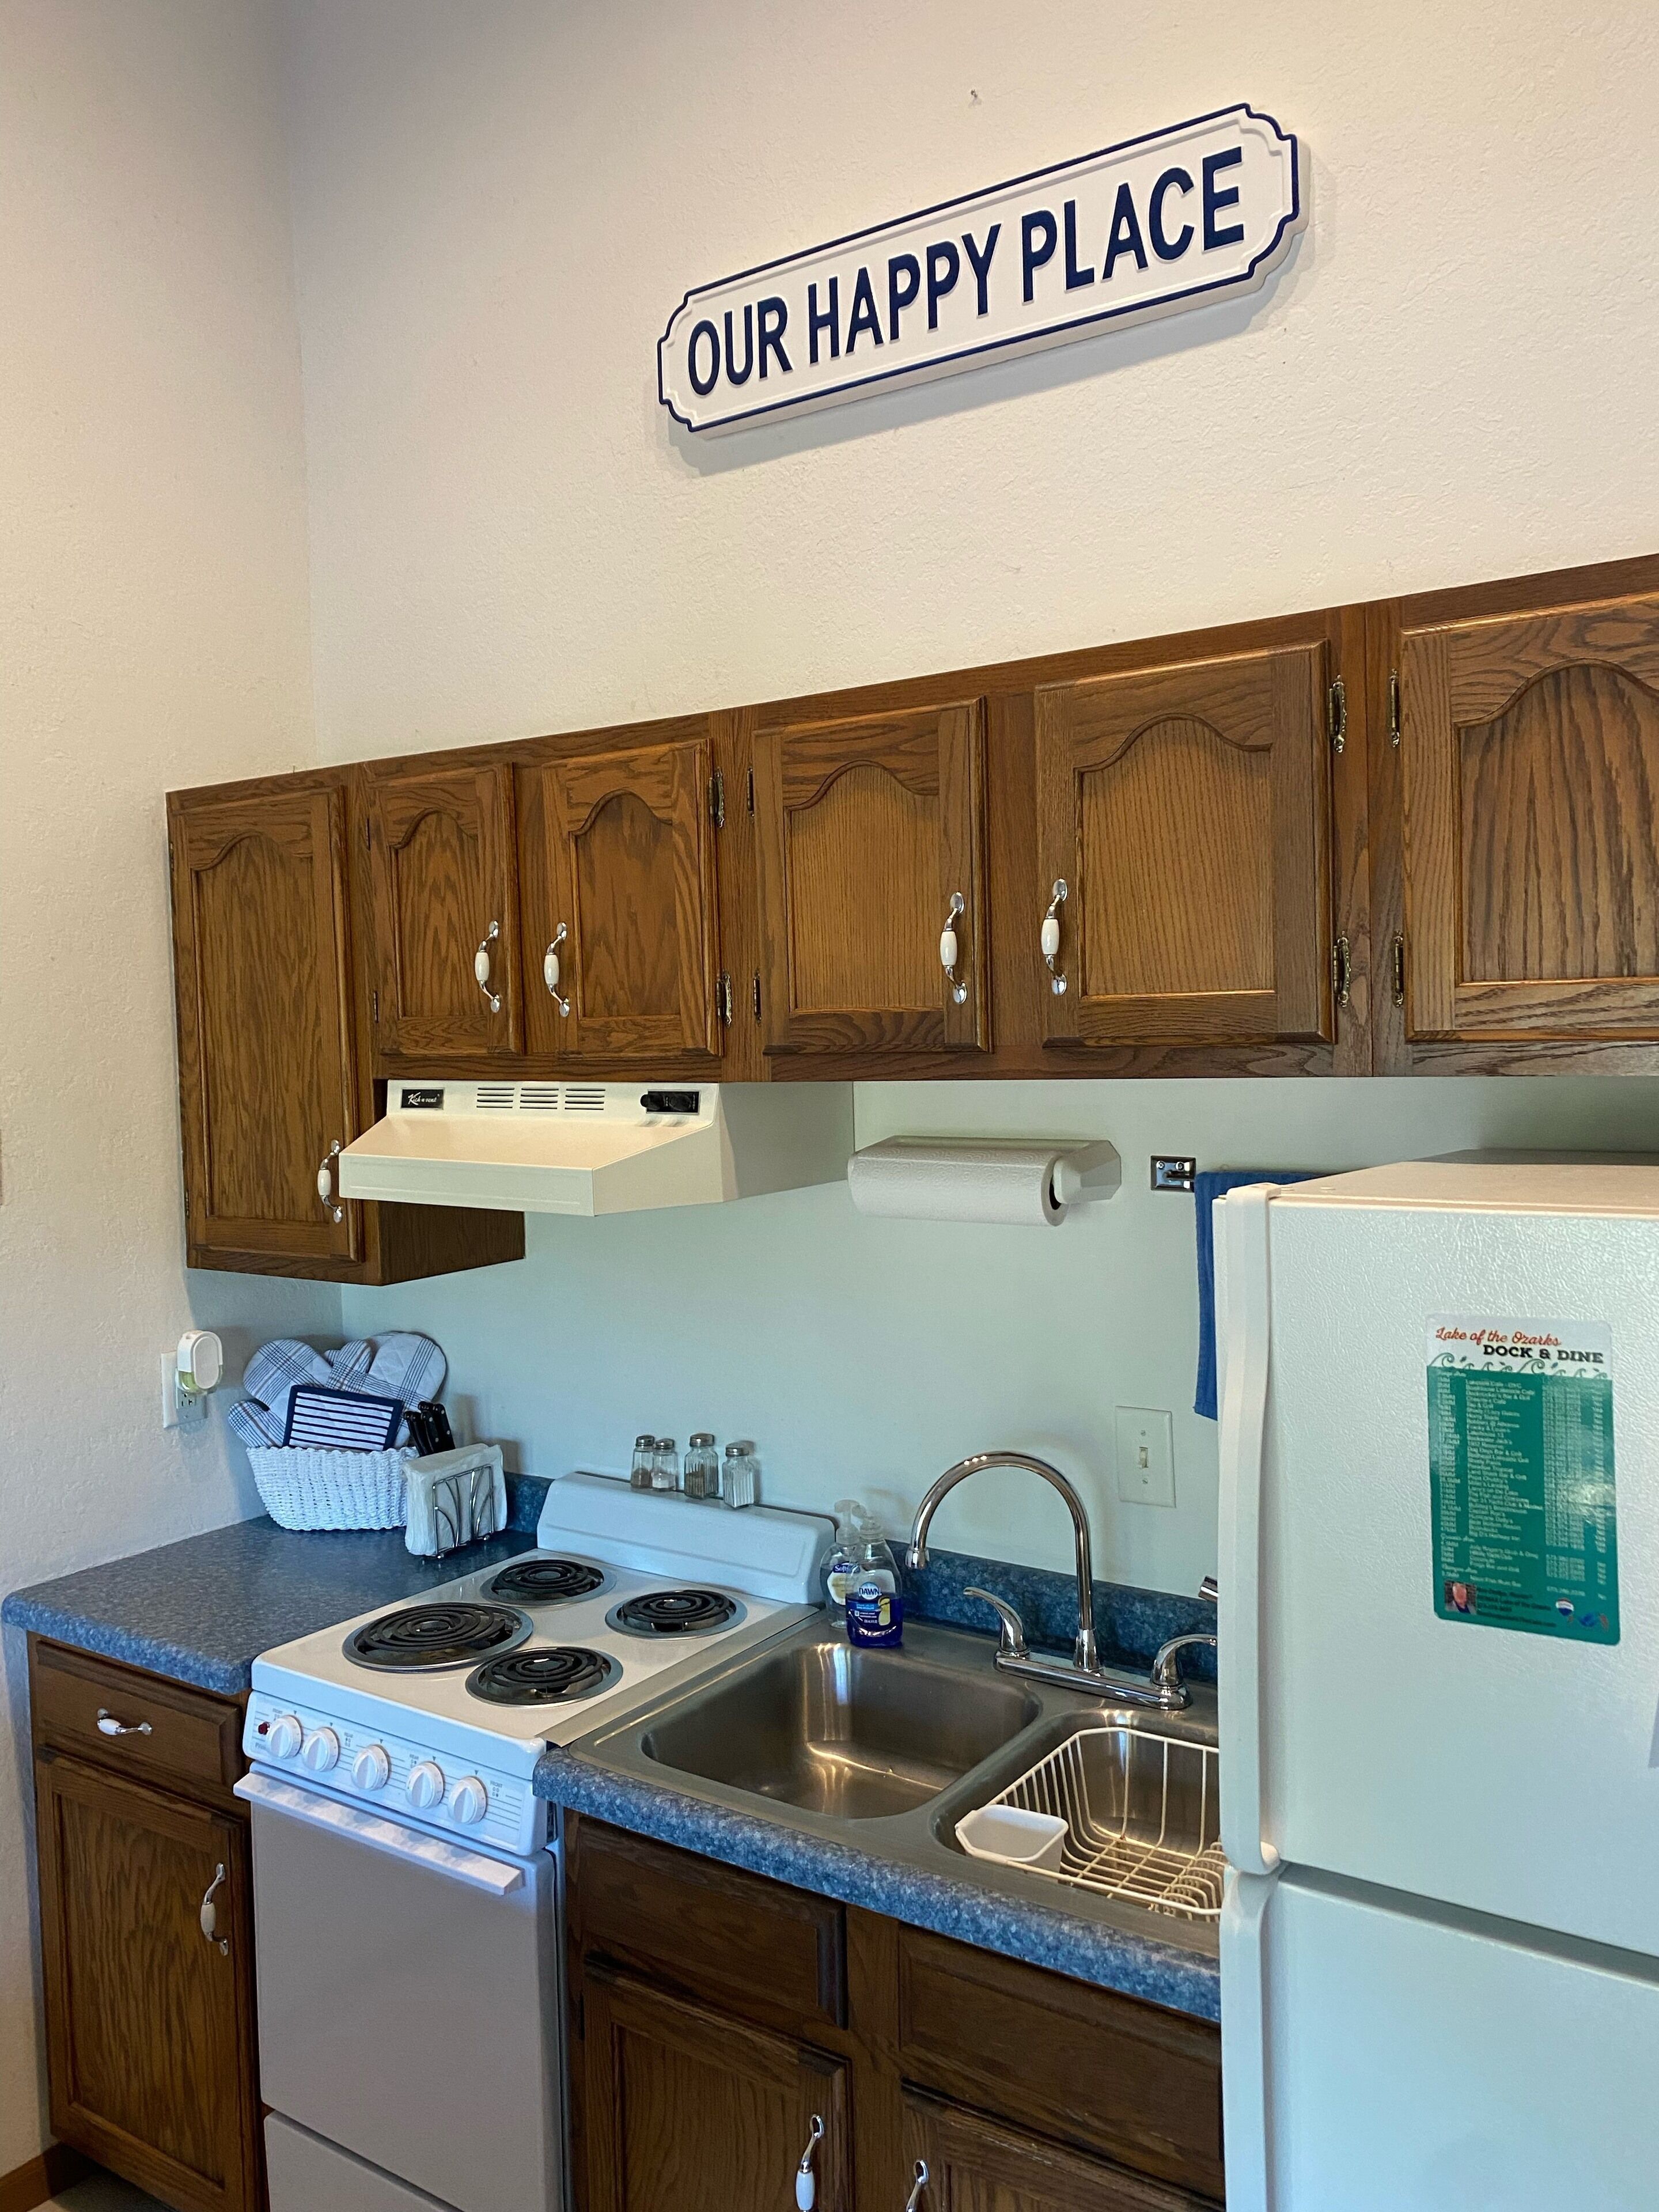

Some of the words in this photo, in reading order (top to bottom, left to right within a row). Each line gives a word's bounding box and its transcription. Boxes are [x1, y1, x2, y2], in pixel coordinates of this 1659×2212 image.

[687, 298, 793, 396] OUR
[808, 224, 1002, 365] HAPPY
[1021, 146, 1245, 303] PLACE
[1436, 1327, 1467, 1341] Lake
[1470, 1329, 1486, 1345] of
[1487, 1330, 1508, 1343] the
[1512, 1331, 1562, 1346] Ozarks
[1483, 1344, 1532, 1358] DOCK
[1539, 1349, 1551, 1359] &
[1557, 1350, 1604, 1363] DINE
[859, 1588, 880, 1596] DAWN
